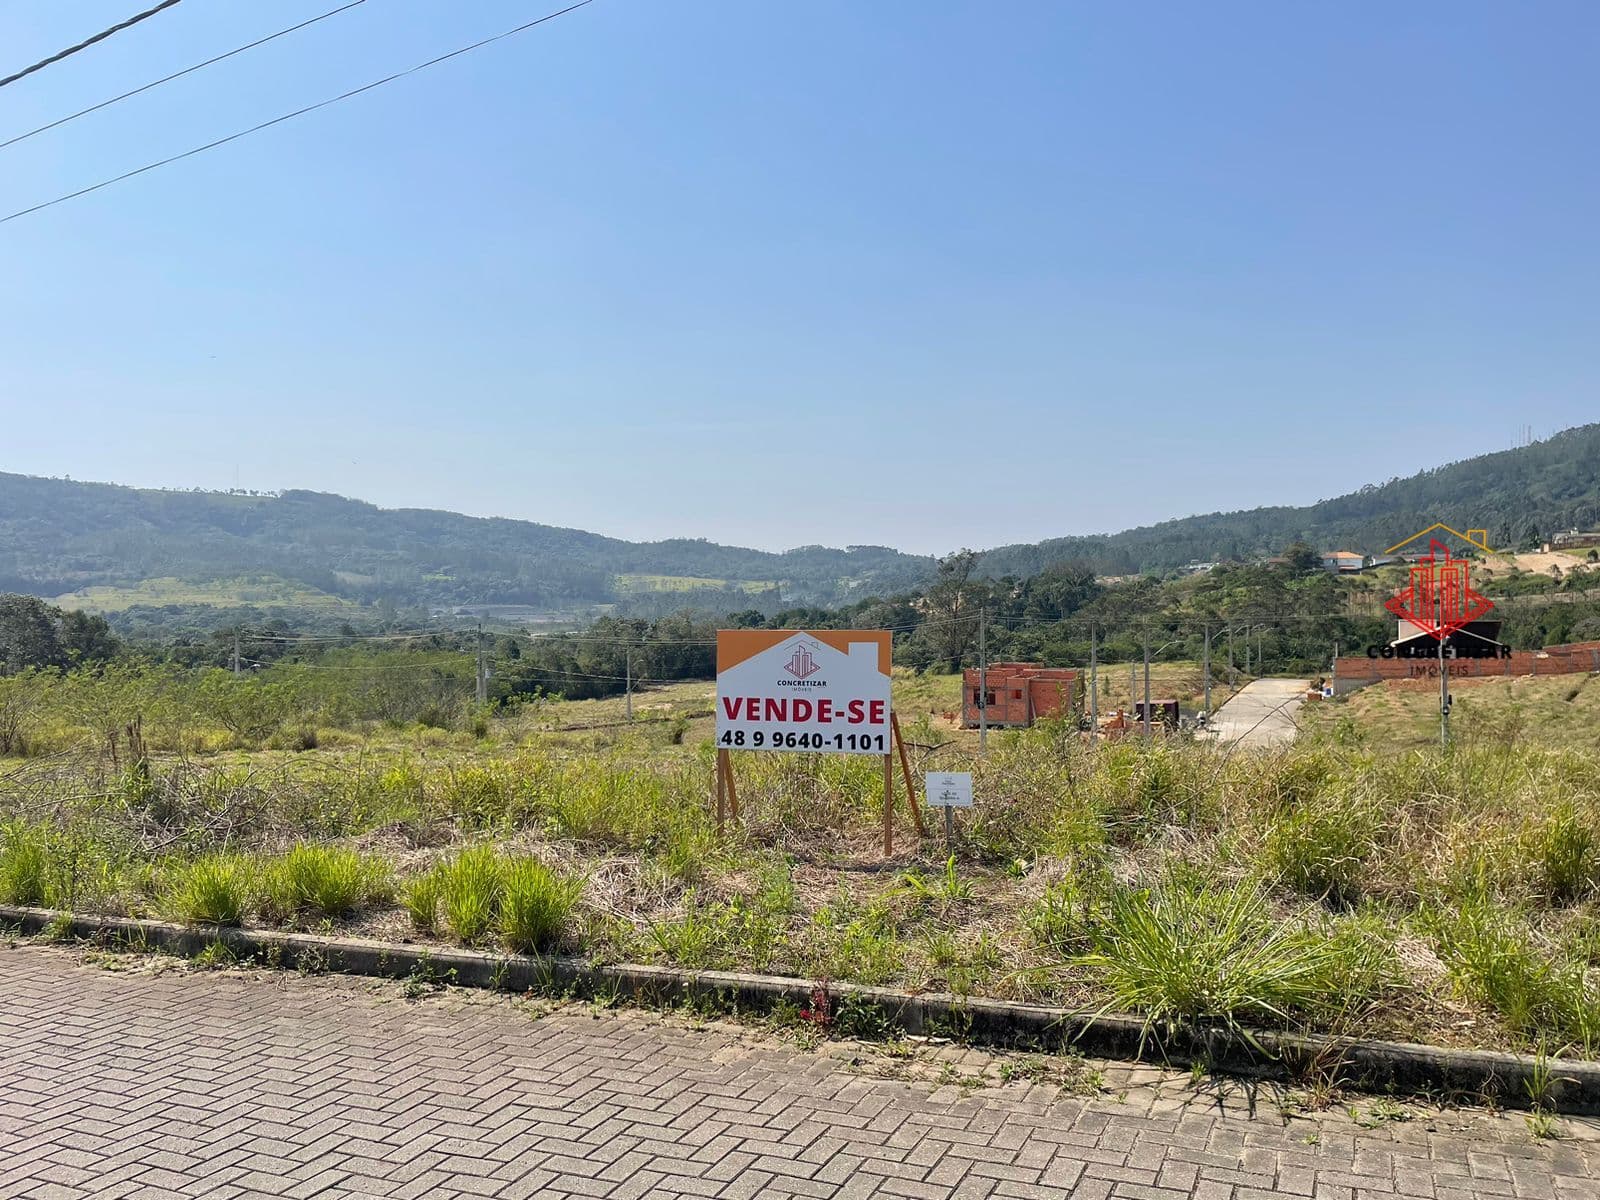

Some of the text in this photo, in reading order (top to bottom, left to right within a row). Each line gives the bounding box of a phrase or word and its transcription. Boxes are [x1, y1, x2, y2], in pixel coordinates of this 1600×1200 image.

[722, 697, 885, 724] VENDE-SE
[721, 730, 884, 750] 48 9 9640-1101
